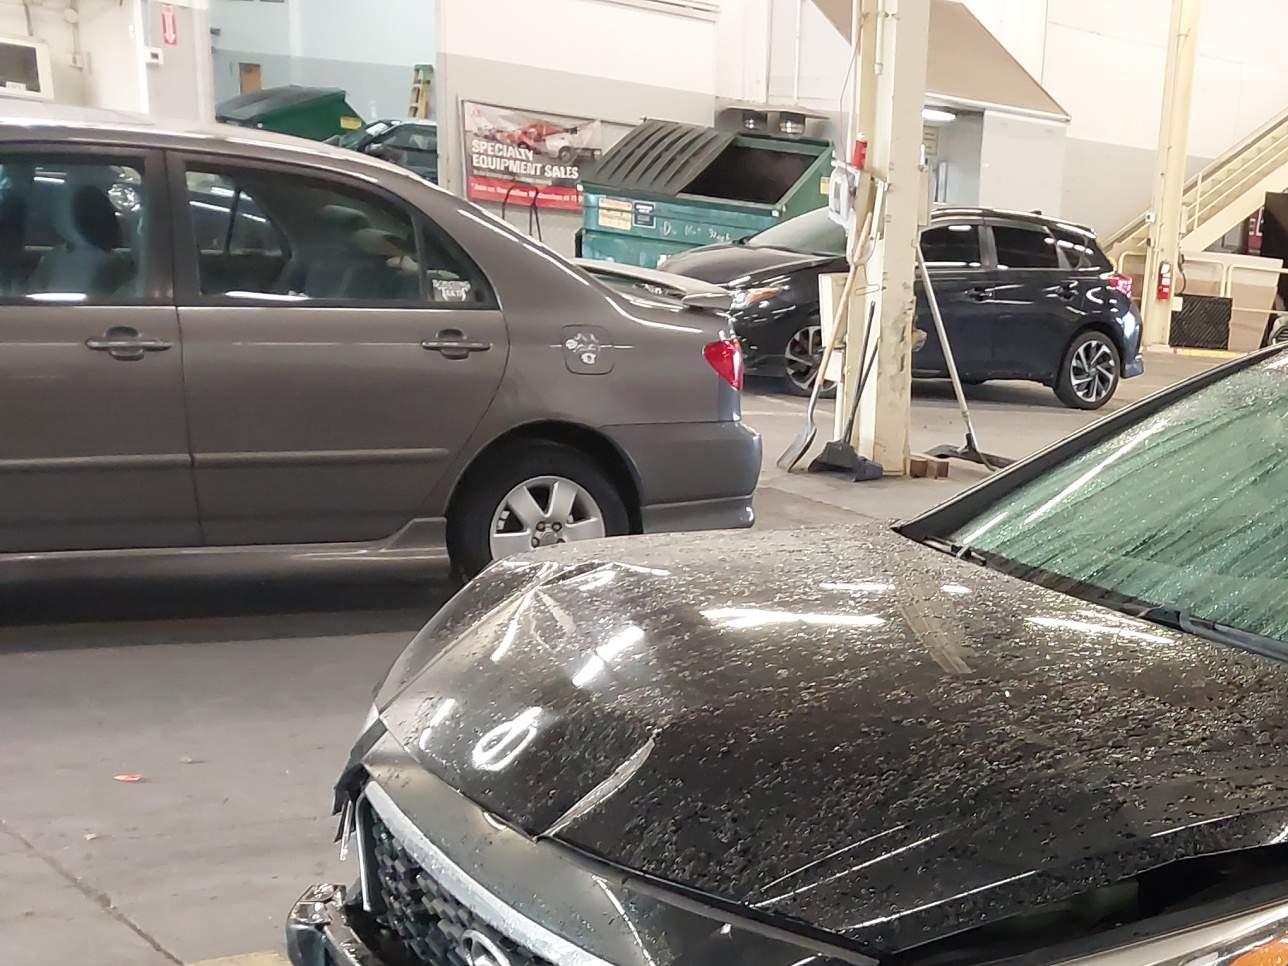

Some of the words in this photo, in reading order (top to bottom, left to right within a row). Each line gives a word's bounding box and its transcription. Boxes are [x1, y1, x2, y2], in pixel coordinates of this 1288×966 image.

[471, 140, 534, 160] SPECIALTY
[472, 154, 542, 175] EQUIPMENT
[544, 164, 579, 179] SALES
